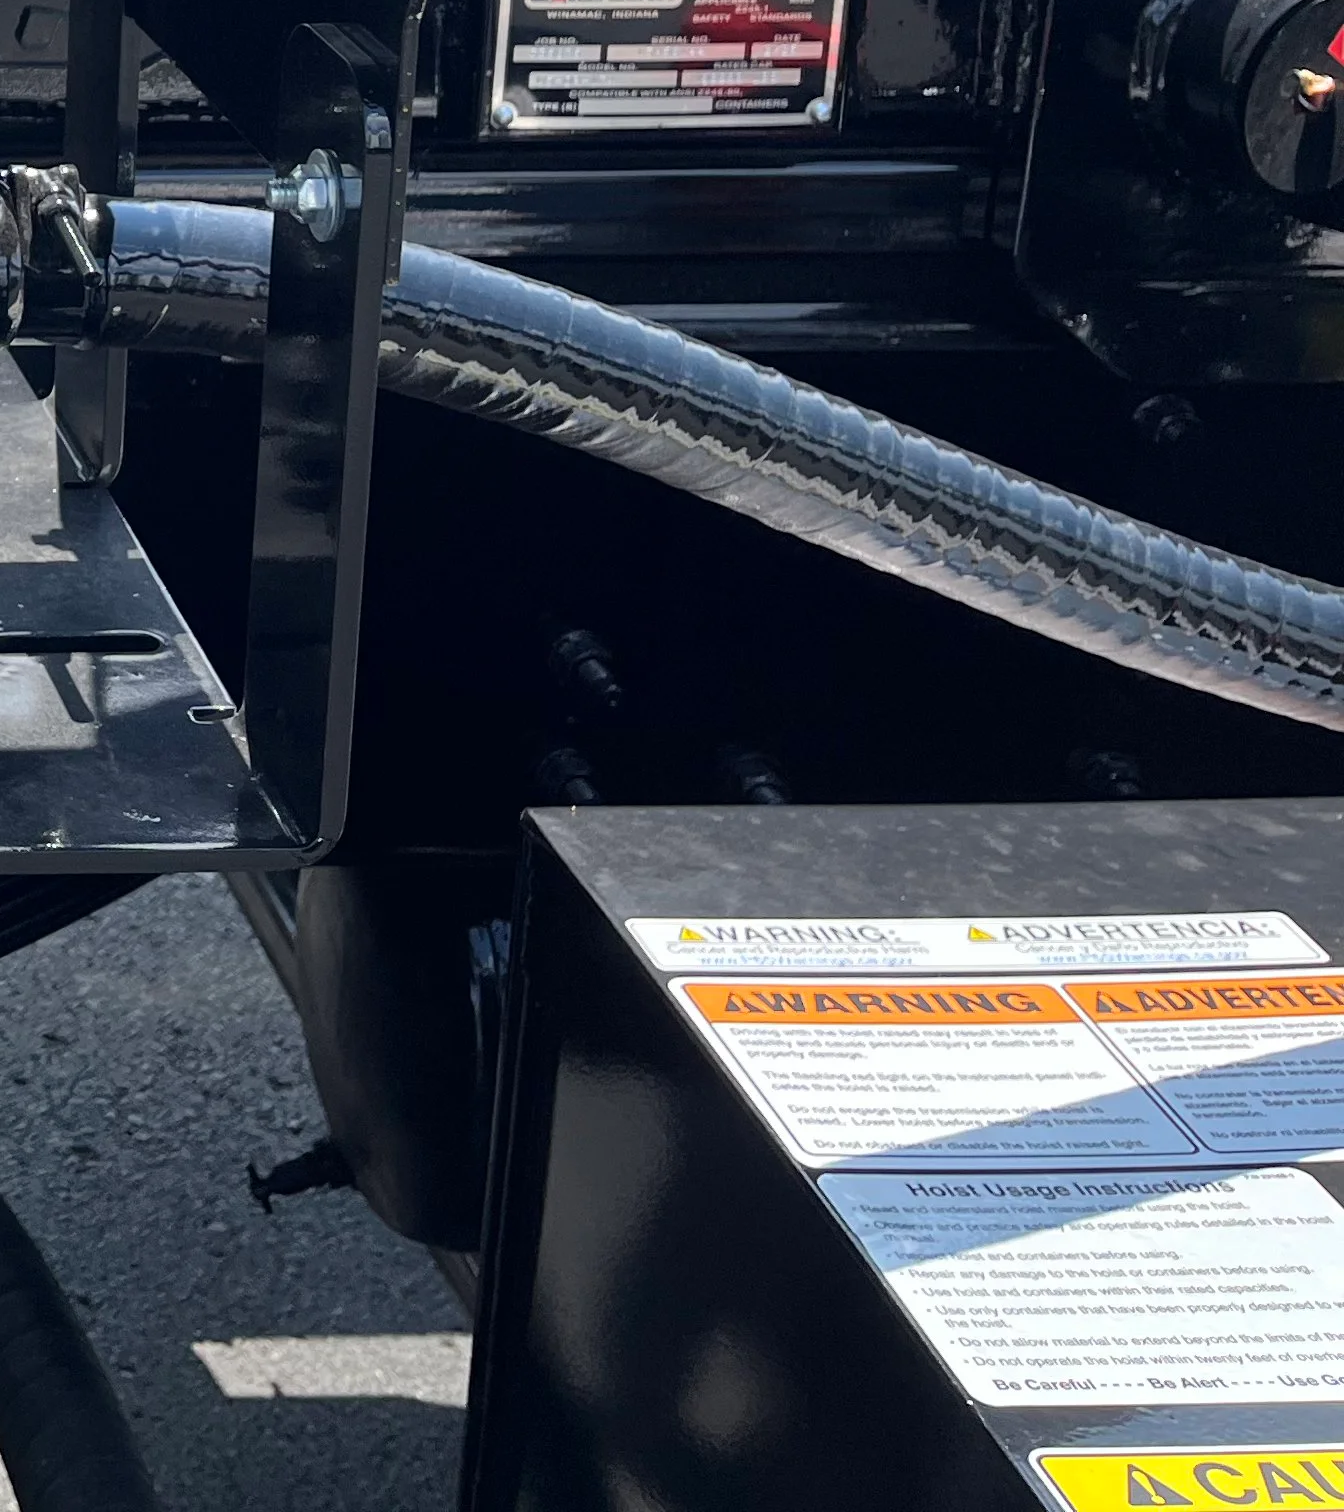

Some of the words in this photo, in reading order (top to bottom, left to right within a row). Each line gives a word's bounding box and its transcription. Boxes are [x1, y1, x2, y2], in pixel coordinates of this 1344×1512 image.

[703, 925, 902, 944] WARNING:
[1002, 919, 1282, 942] ADVERTENCIA:
[753, 992, 1042, 1015] WARNING
[905, 1182, 982, 1198] Hoist
[983, 1182, 1071, 1200] Usage
[1073, 1179, 1235, 1197] Instructions
[921, 1287, 952, 1297] Use
[953, 1287, 990, 1297] hoist
[994, 1287, 1020, 1297] and
[1022, 1286, 1097, 1297] containers
[1100, 1285, 1141, 1296] within
[1141, 1285, 1174, 1295] their
[1178, 1284, 1215, 1294] rated
[958, 1337, 981, 1347] Do
[984, 1337, 1010, 1347] not
[1011, 1337, 1048, 1347] allow
[1052, 1336, 1111, 1346] material
[1112, 1336, 1128, 1346] to
[1131, 1335, 1181, 1346] extend
[1181, 1334, 1238, 1347] beyond
[1239, 1333, 1264, 1343] the
[1264, 1333, 1305, 1343] limits
[972, 1356, 995, 1366] Do
[998, 1356, 1023, 1366] not
[1026, 1356, 1082, 1369] operate
[1083, 1356, 1108, 1365] the
[1110, 1355, 1148, 1365] hoist
[1149, 1355, 1193, 1365] within
[1194, 1354, 1244, 1366] twenty
[992, 1378, 1022, 1391] Be
[1024, 1378, 1097, 1391] Careful
[1147, 1376, 1176, 1389] Be
[1180, 1376, 1229, 1389] Alert
[1277, 1374, 1319, 1387] Use
